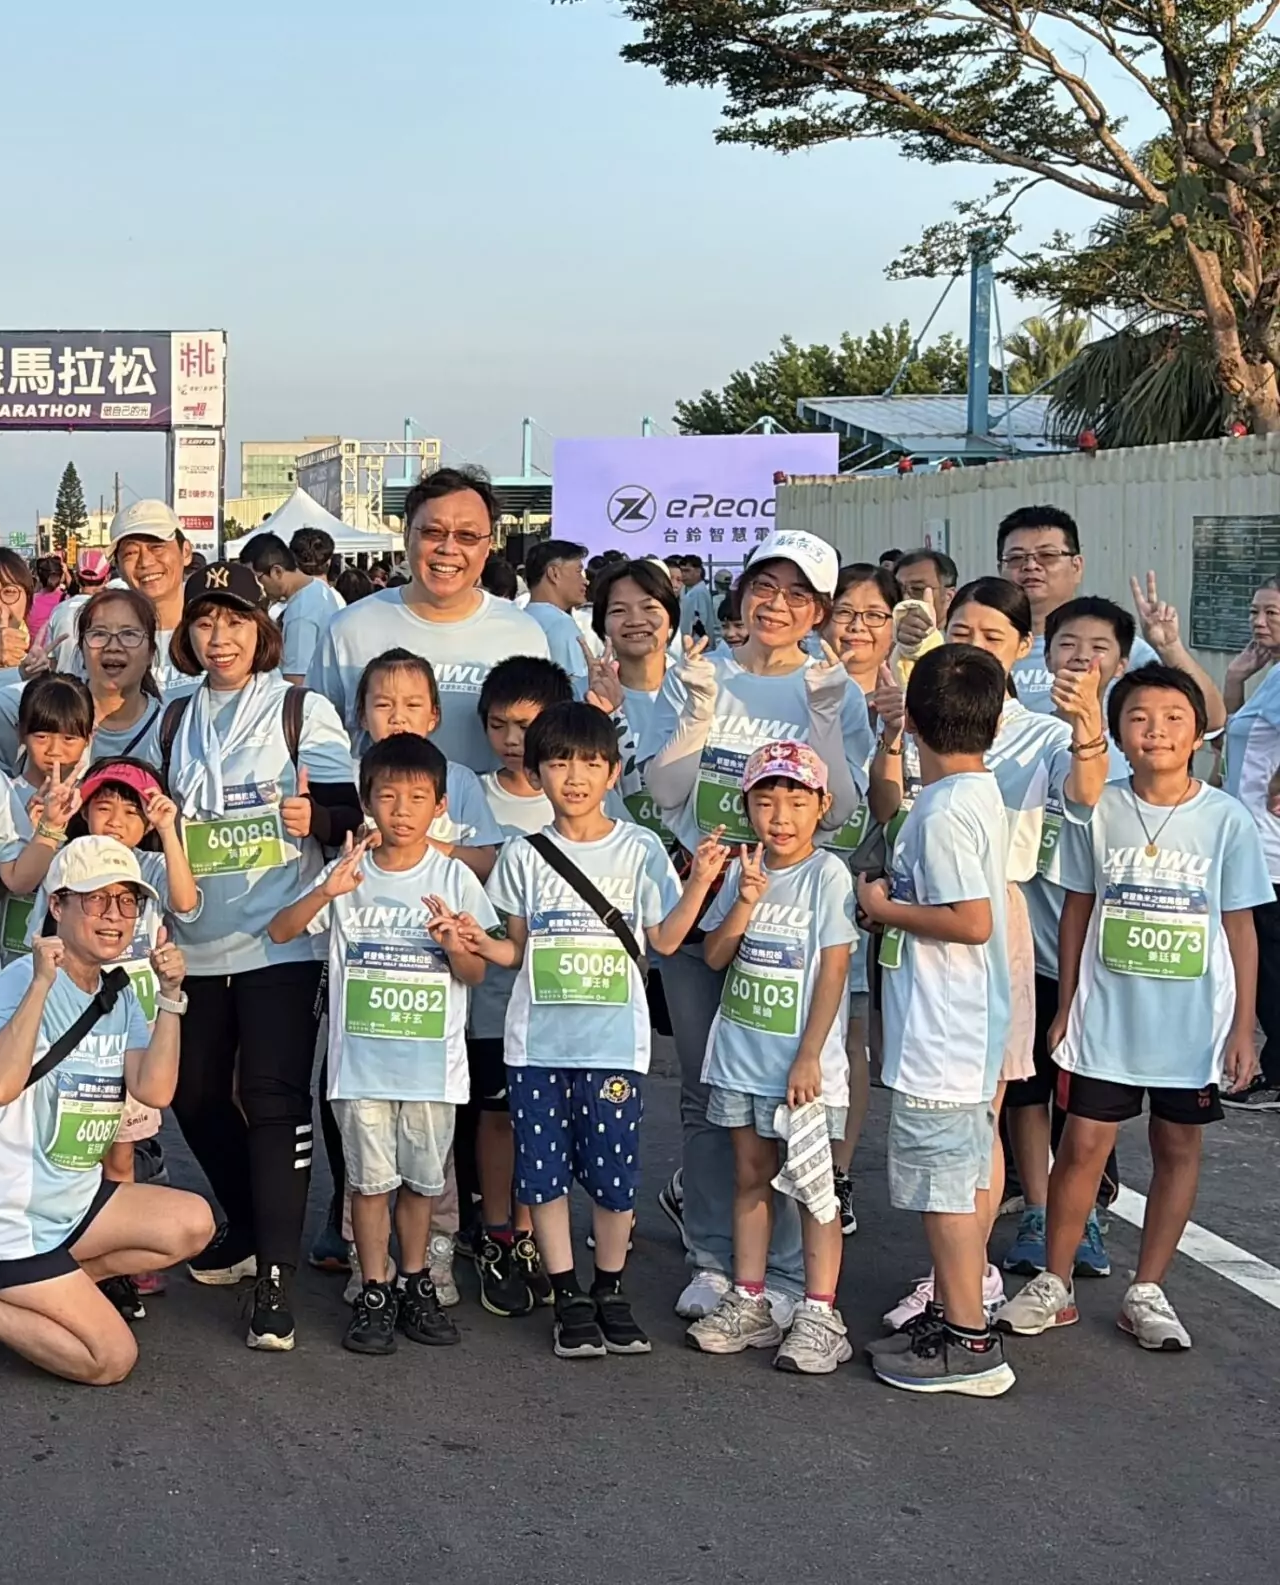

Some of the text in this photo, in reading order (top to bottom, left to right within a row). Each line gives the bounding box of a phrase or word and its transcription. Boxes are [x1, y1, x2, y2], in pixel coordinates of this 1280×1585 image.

[205, 566, 230, 589] NY
[208, 821, 276, 849] 60088
[1103, 846, 1213, 875] XINWU
[1126, 926, 1202, 953] 50073
[558, 953, 626, 977] 50084
[368, 986, 444, 1012] 50082
[731, 975, 795, 1009] 60103
[76, 1119, 120, 1143] 60087
[126, 1113, 149, 1127] Smile
